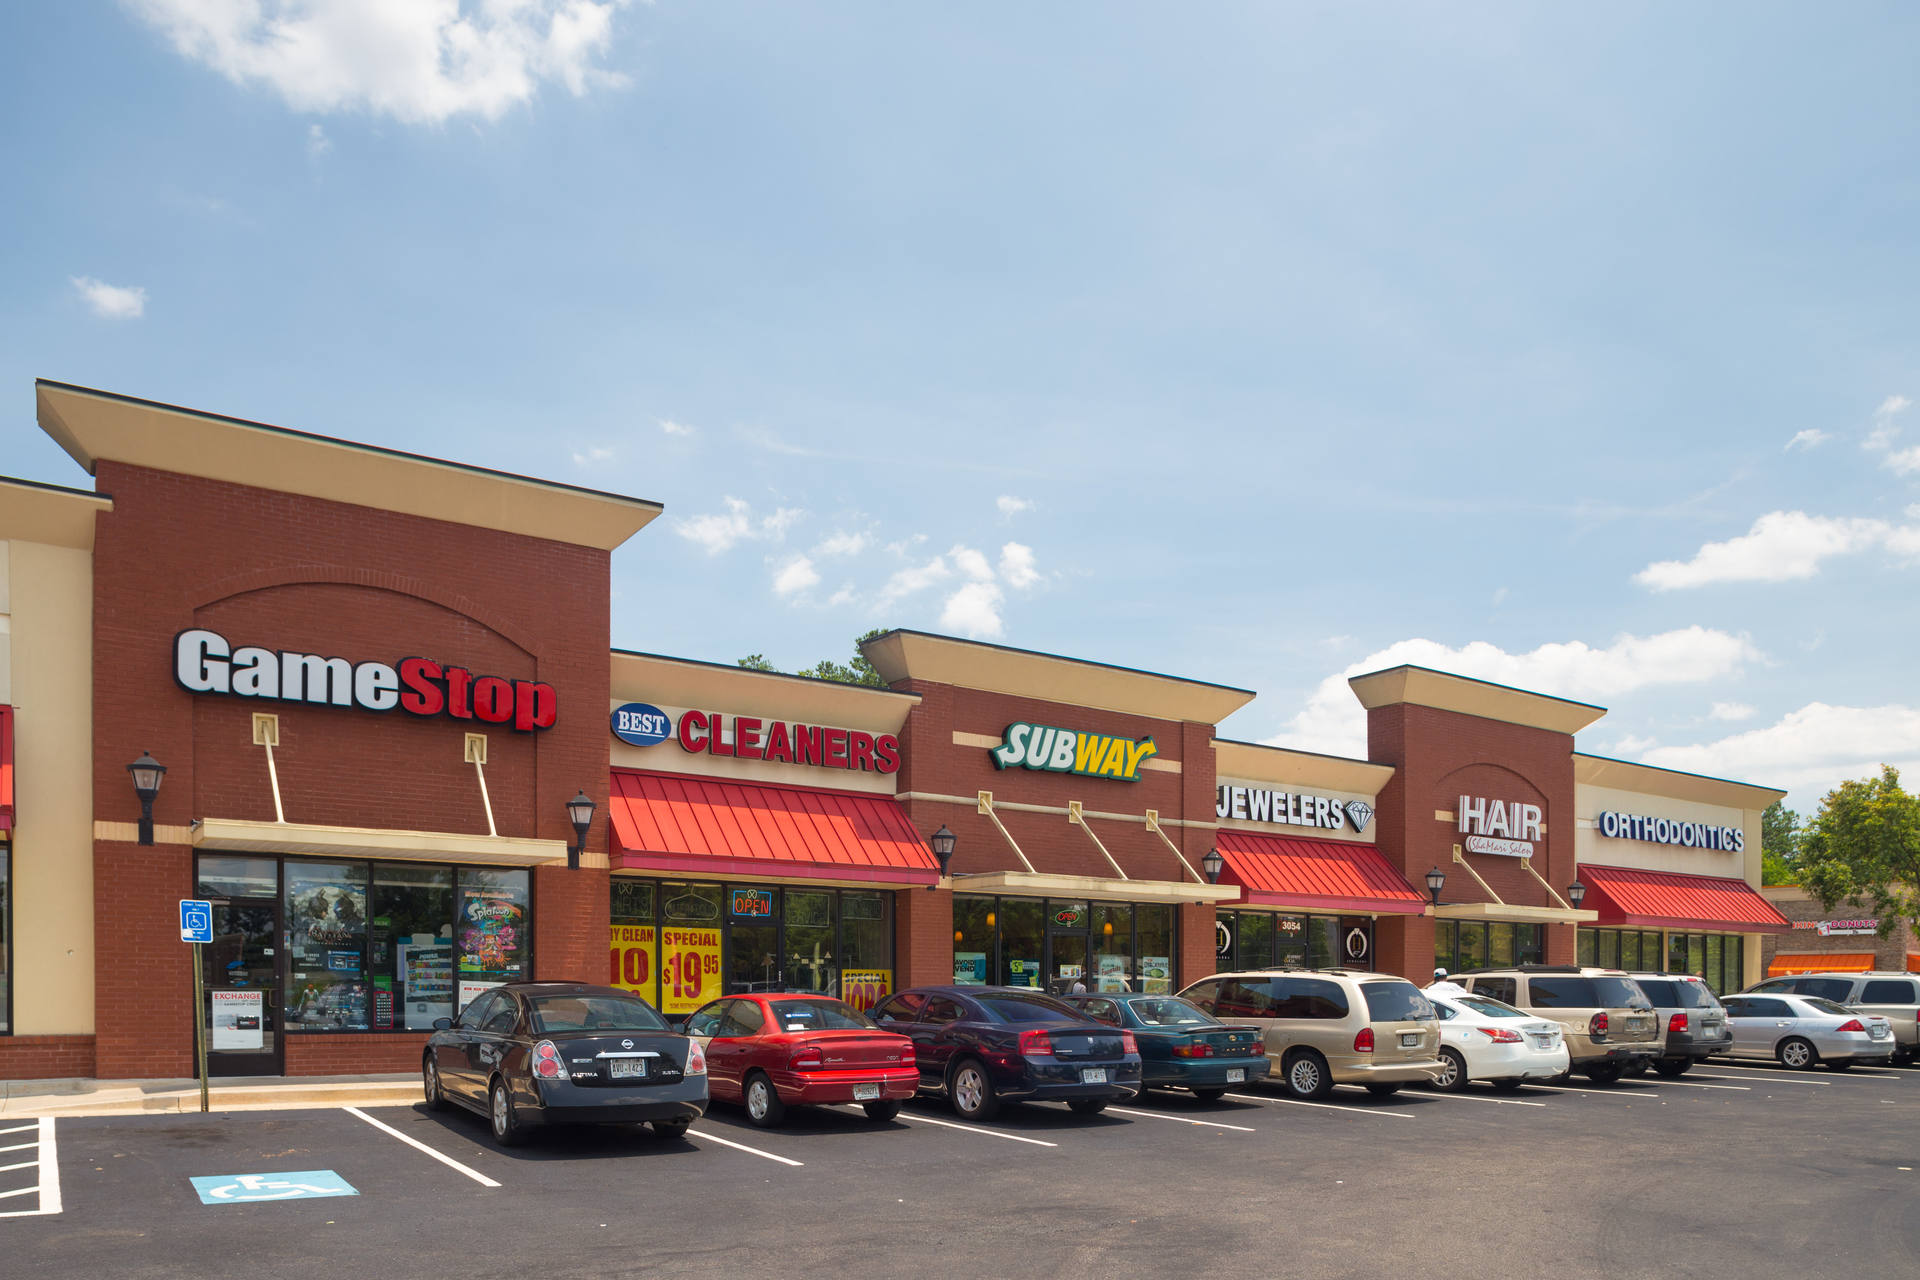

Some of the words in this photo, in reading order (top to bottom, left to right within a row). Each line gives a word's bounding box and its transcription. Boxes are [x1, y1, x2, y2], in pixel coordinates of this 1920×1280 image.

[176, 629, 557, 732] GameStop
[618, 710, 665, 735] BEST
[678, 710, 900, 774] CLEANERS
[996, 723, 1158, 778] SUBWAY
[1216, 785, 1345, 830] JEWELERS
[1459, 795, 1542, 842] HAIR
[1600, 811, 1745, 853] ORTHODONTICS
[1509, 842, 1532, 855] Salon
[467, 903, 510, 921] Splatoon
[735, 898, 770, 915] OPEN
[1057, 912, 1077, 921] OPEN
[1831, 920, 1878, 929] DONUTS
[1282, 921, 1301, 930] 3054
[622, 928, 654, 943] CLEAN
[664, 931, 718, 947] SPECIAL
[703, 954, 719, 975] 95
[845, 973, 888, 983] SPECIAL
[214, 992, 261, 1000] EXCHANGE
